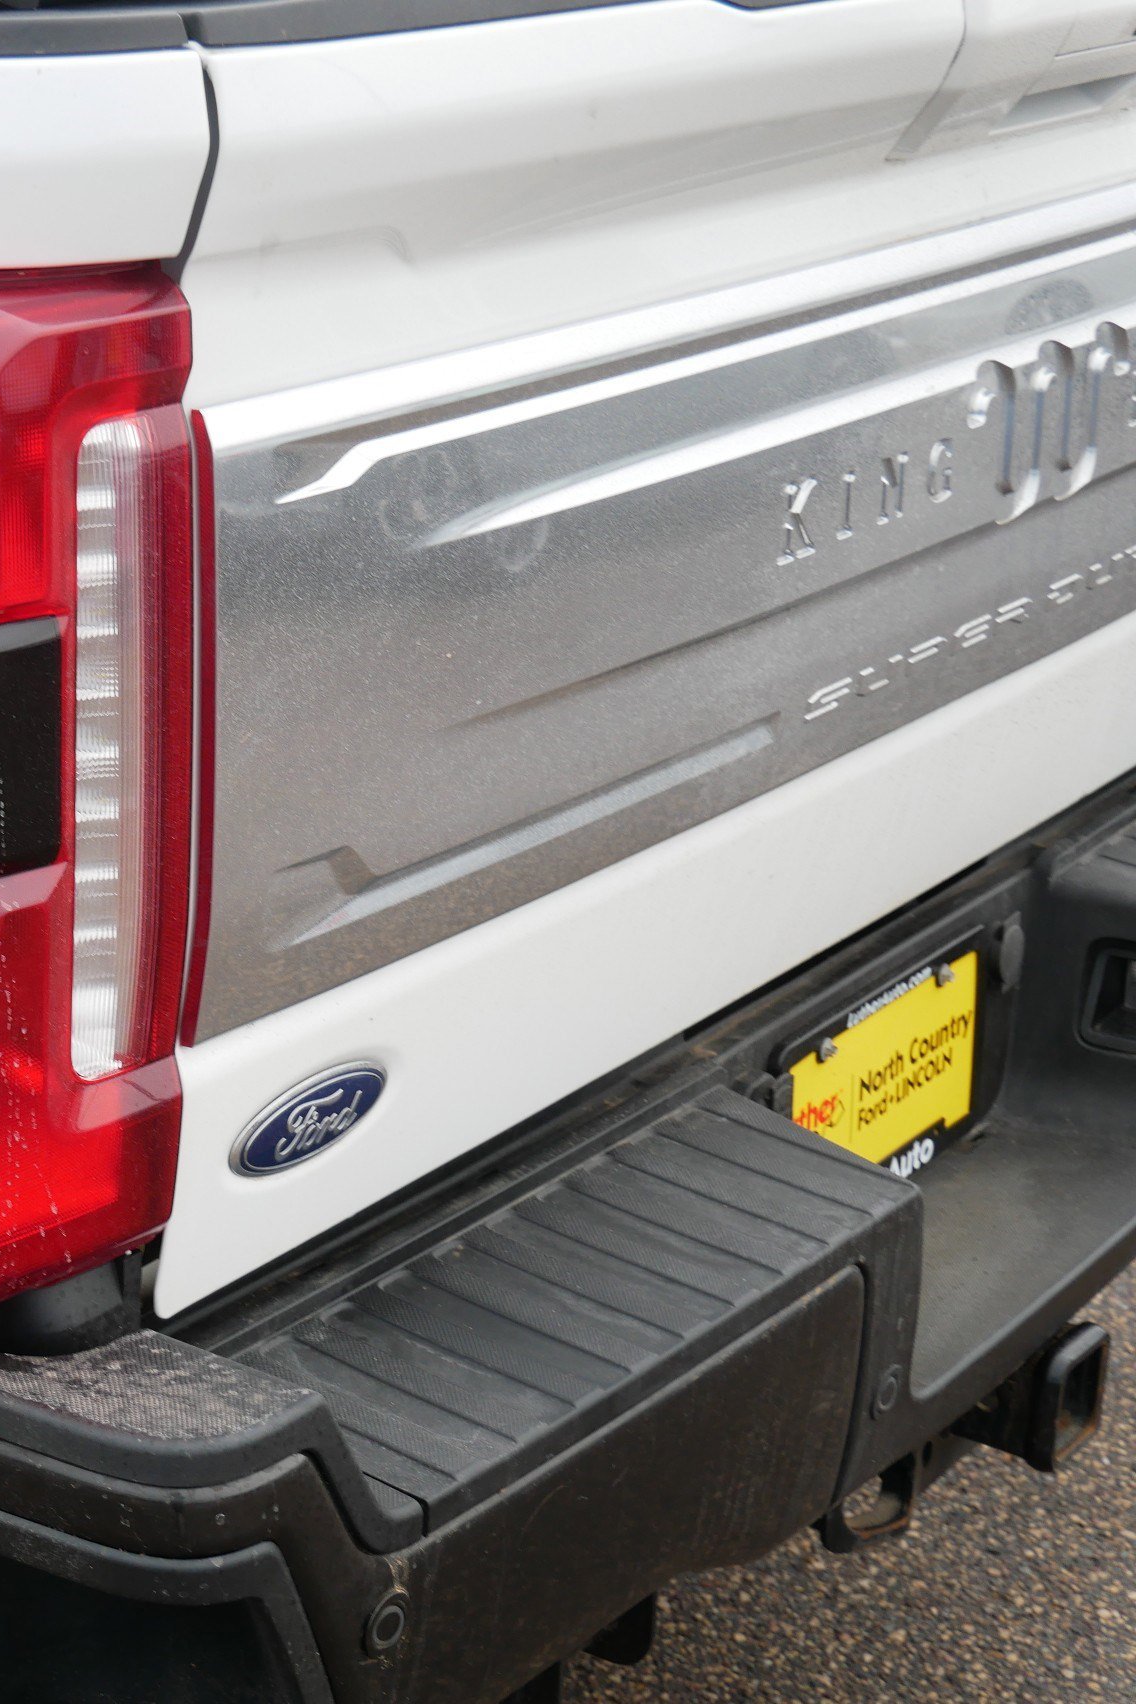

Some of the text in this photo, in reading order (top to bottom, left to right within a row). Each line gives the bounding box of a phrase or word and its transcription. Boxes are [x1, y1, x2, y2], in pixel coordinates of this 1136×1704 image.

[776, 437, 953, 566] KING
[804, 545, 1136, 722] SUPER DU
[858, 1010, 972, 1101] North Country
[274, 1088, 363, 1162] Ford
[793, 1093, 838, 1130] ther
